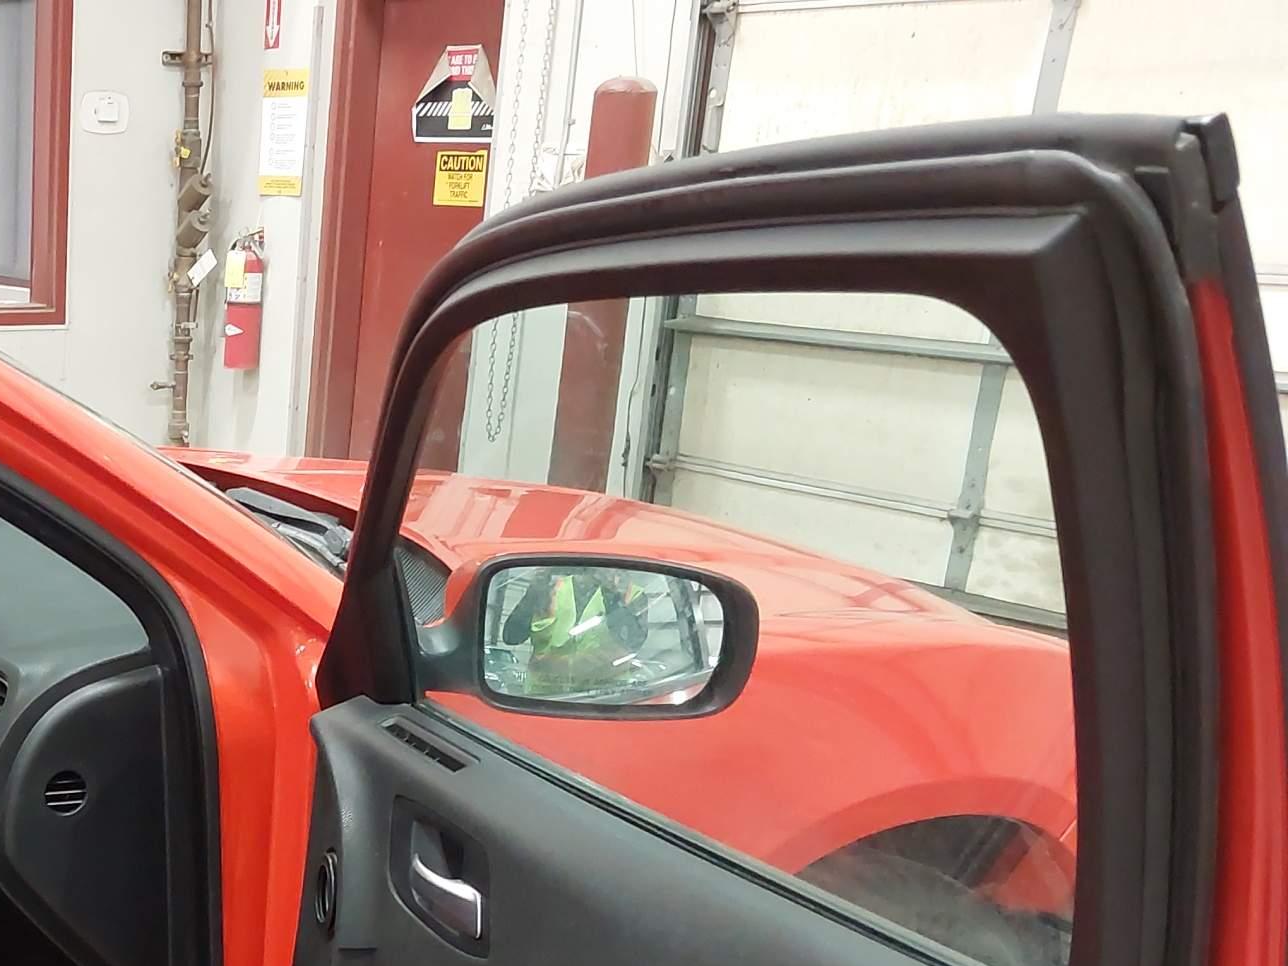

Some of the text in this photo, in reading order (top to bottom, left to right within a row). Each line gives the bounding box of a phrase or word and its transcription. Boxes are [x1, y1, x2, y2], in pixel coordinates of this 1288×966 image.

[268, 81, 305, 91] WARNING
[441, 156, 483, 171] CAUTION
[464, 173, 474, 181] FOR
[448, 182, 470, 190] FORKLIFT
[450, 190, 469, 199] TRAFFIC
